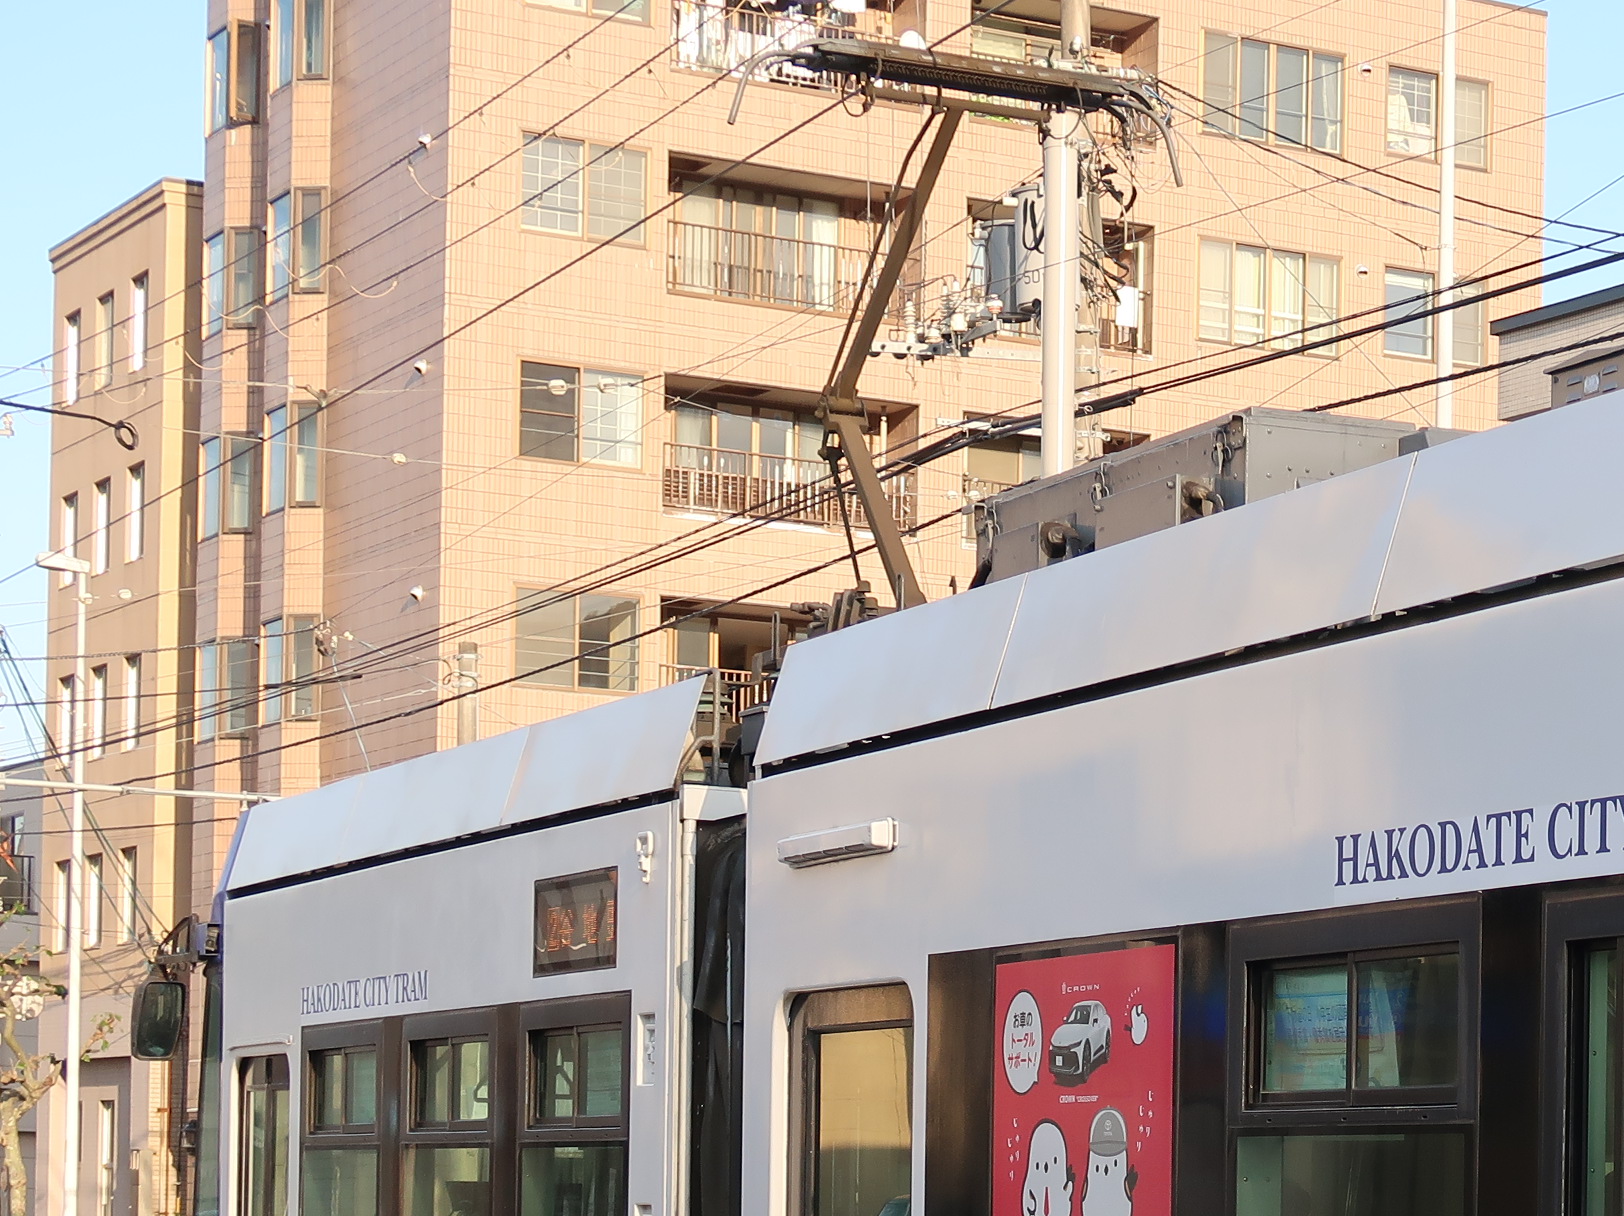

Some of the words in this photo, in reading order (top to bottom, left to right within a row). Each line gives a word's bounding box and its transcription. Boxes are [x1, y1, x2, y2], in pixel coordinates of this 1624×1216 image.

[1334, 808, 1536, 887] HAKODATE
[300, 979, 361, 1015] HAKODATE
[363, 974, 393, 1008] CITY
[393, 970, 428, 1002] TRAM
[1066, 983, 1100, 994] CROWN
[1012, 1011, 1034, 1029] お車の
[1010, 1032, 1036, 1050] トータル
